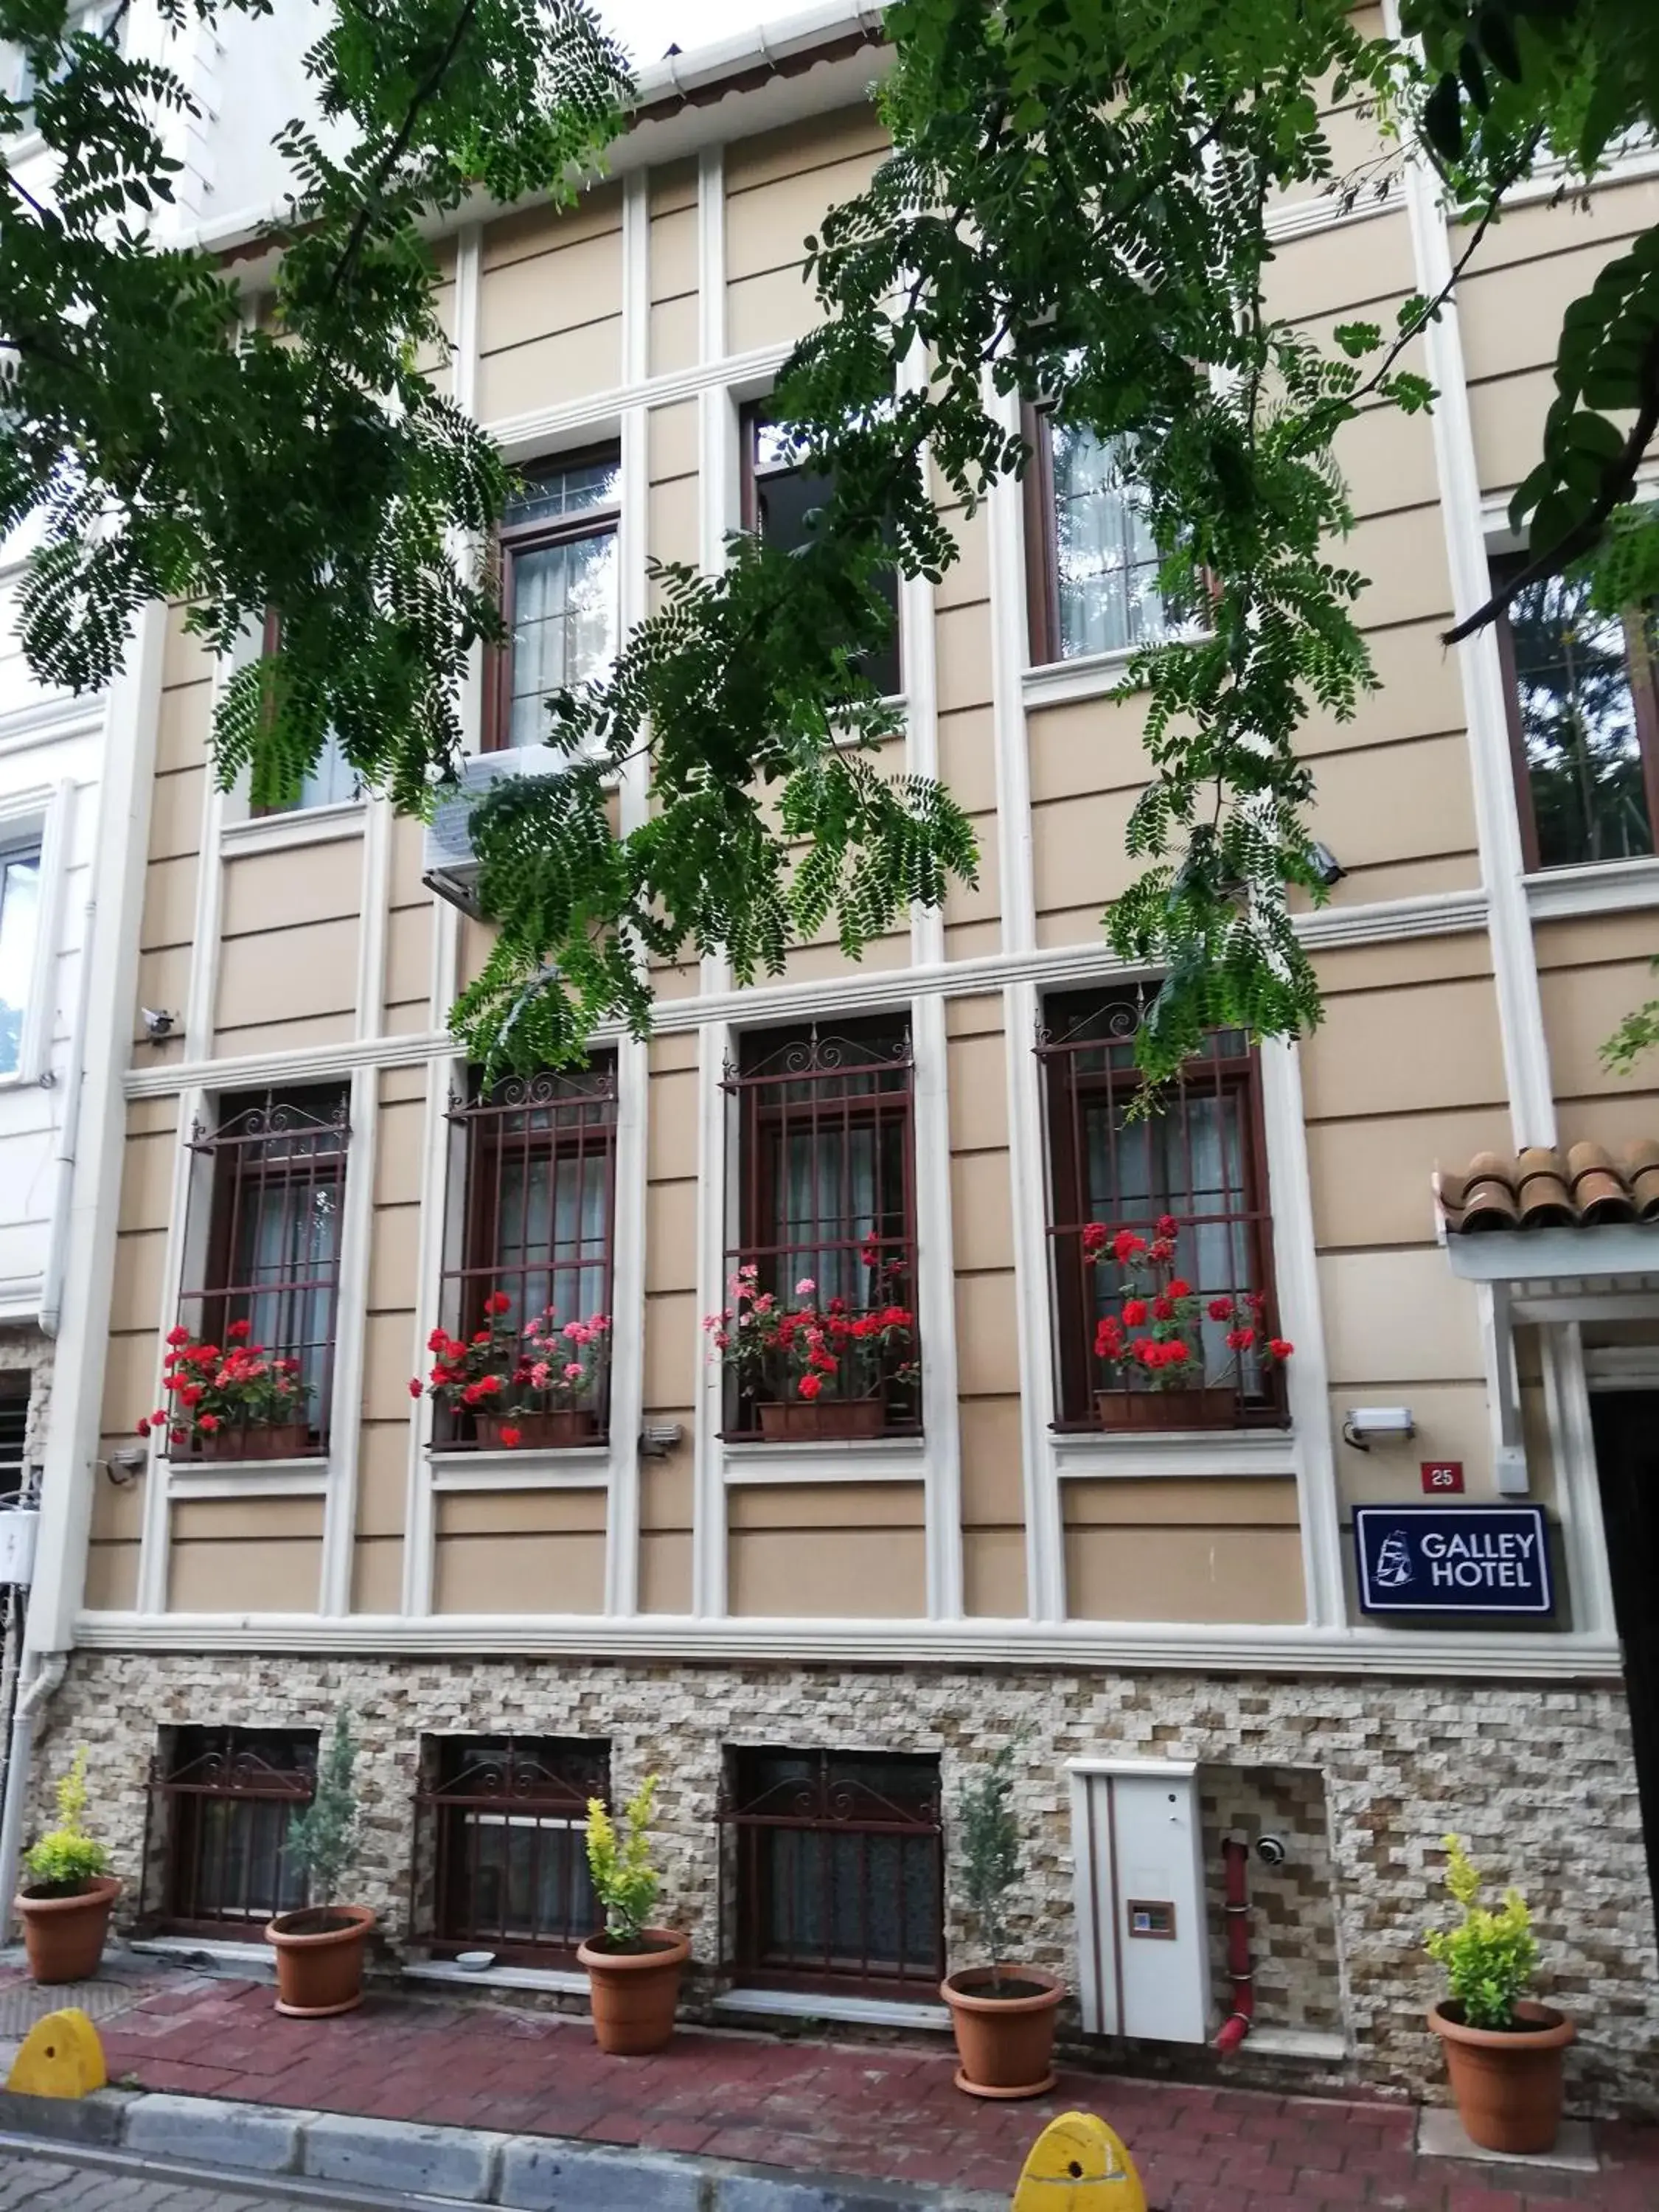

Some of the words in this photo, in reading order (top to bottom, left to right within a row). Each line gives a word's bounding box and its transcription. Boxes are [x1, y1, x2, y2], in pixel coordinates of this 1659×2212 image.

[1432, 1470, 1453, 1486] 25
[1420, 1533, 1534, 1559] GALLEY
[1432, 1561, 1532, 1587] HOTEL
